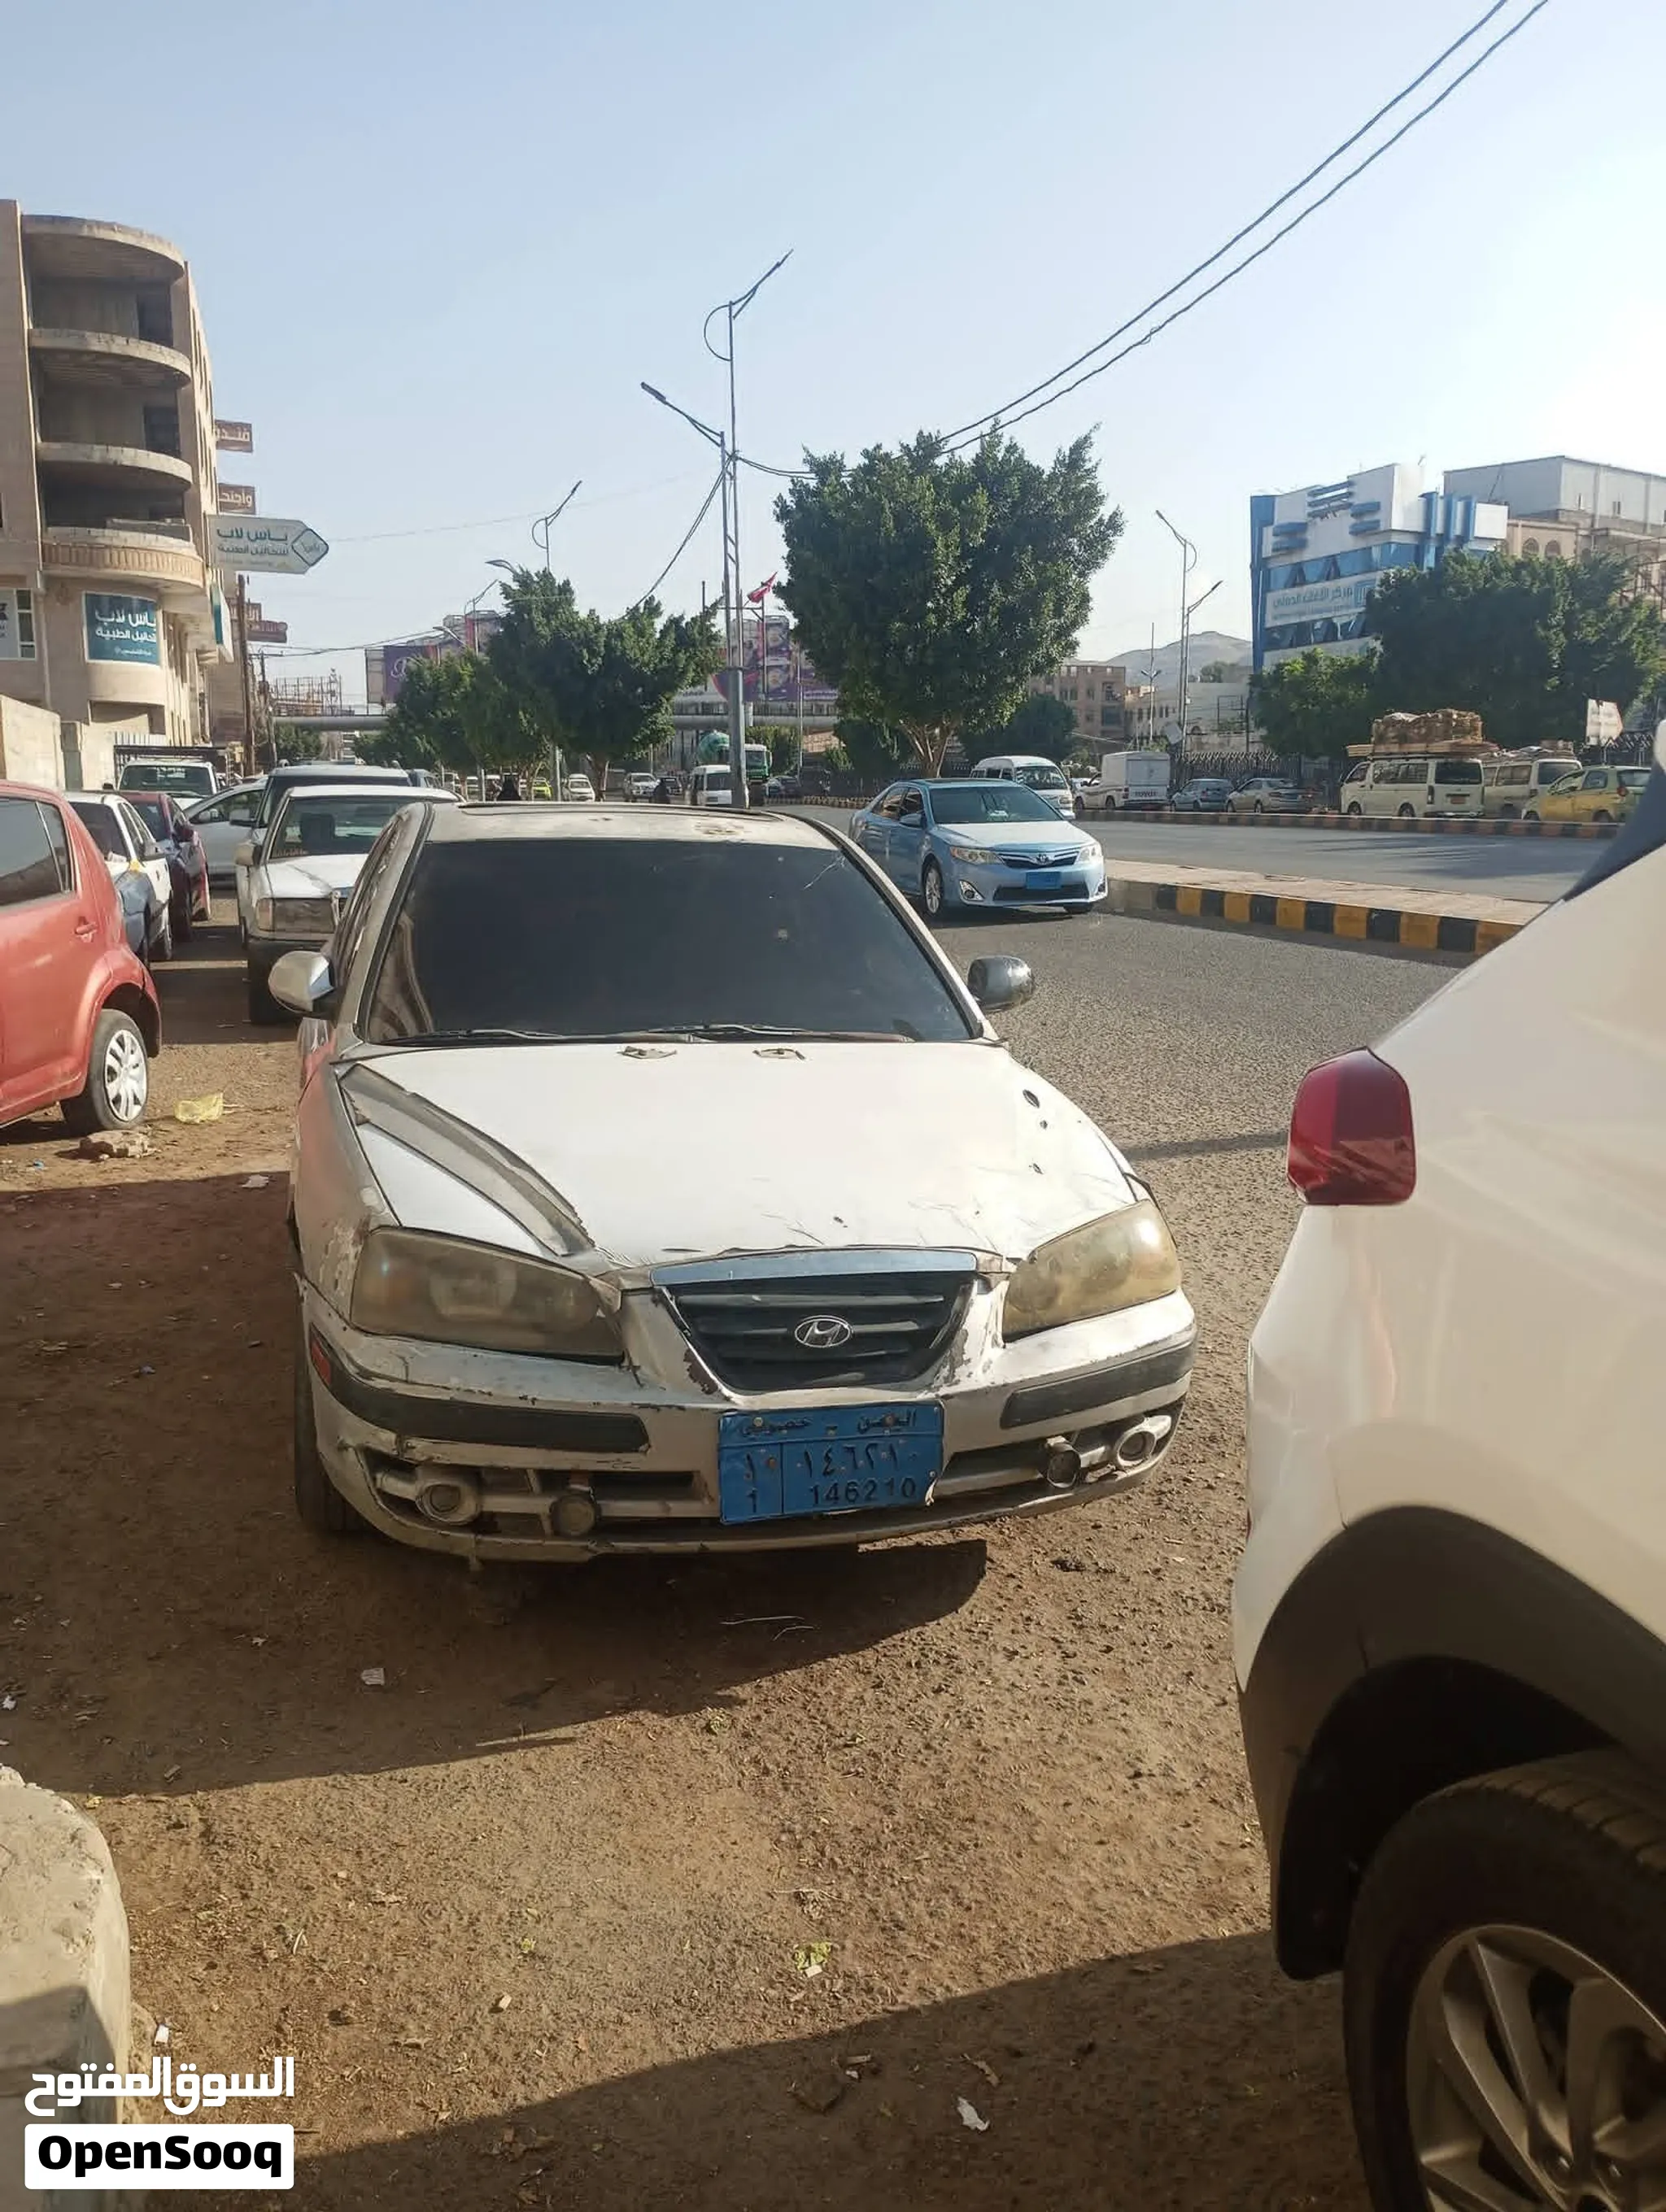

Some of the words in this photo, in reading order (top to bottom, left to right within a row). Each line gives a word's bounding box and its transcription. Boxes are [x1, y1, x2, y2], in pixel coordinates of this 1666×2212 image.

[94, 608, 125, 626] لاب
[95, 627, 130, 640] الطبية
[746, 1489, 757, 1513] 1
[809, 1476, 917, 1505] 146210
